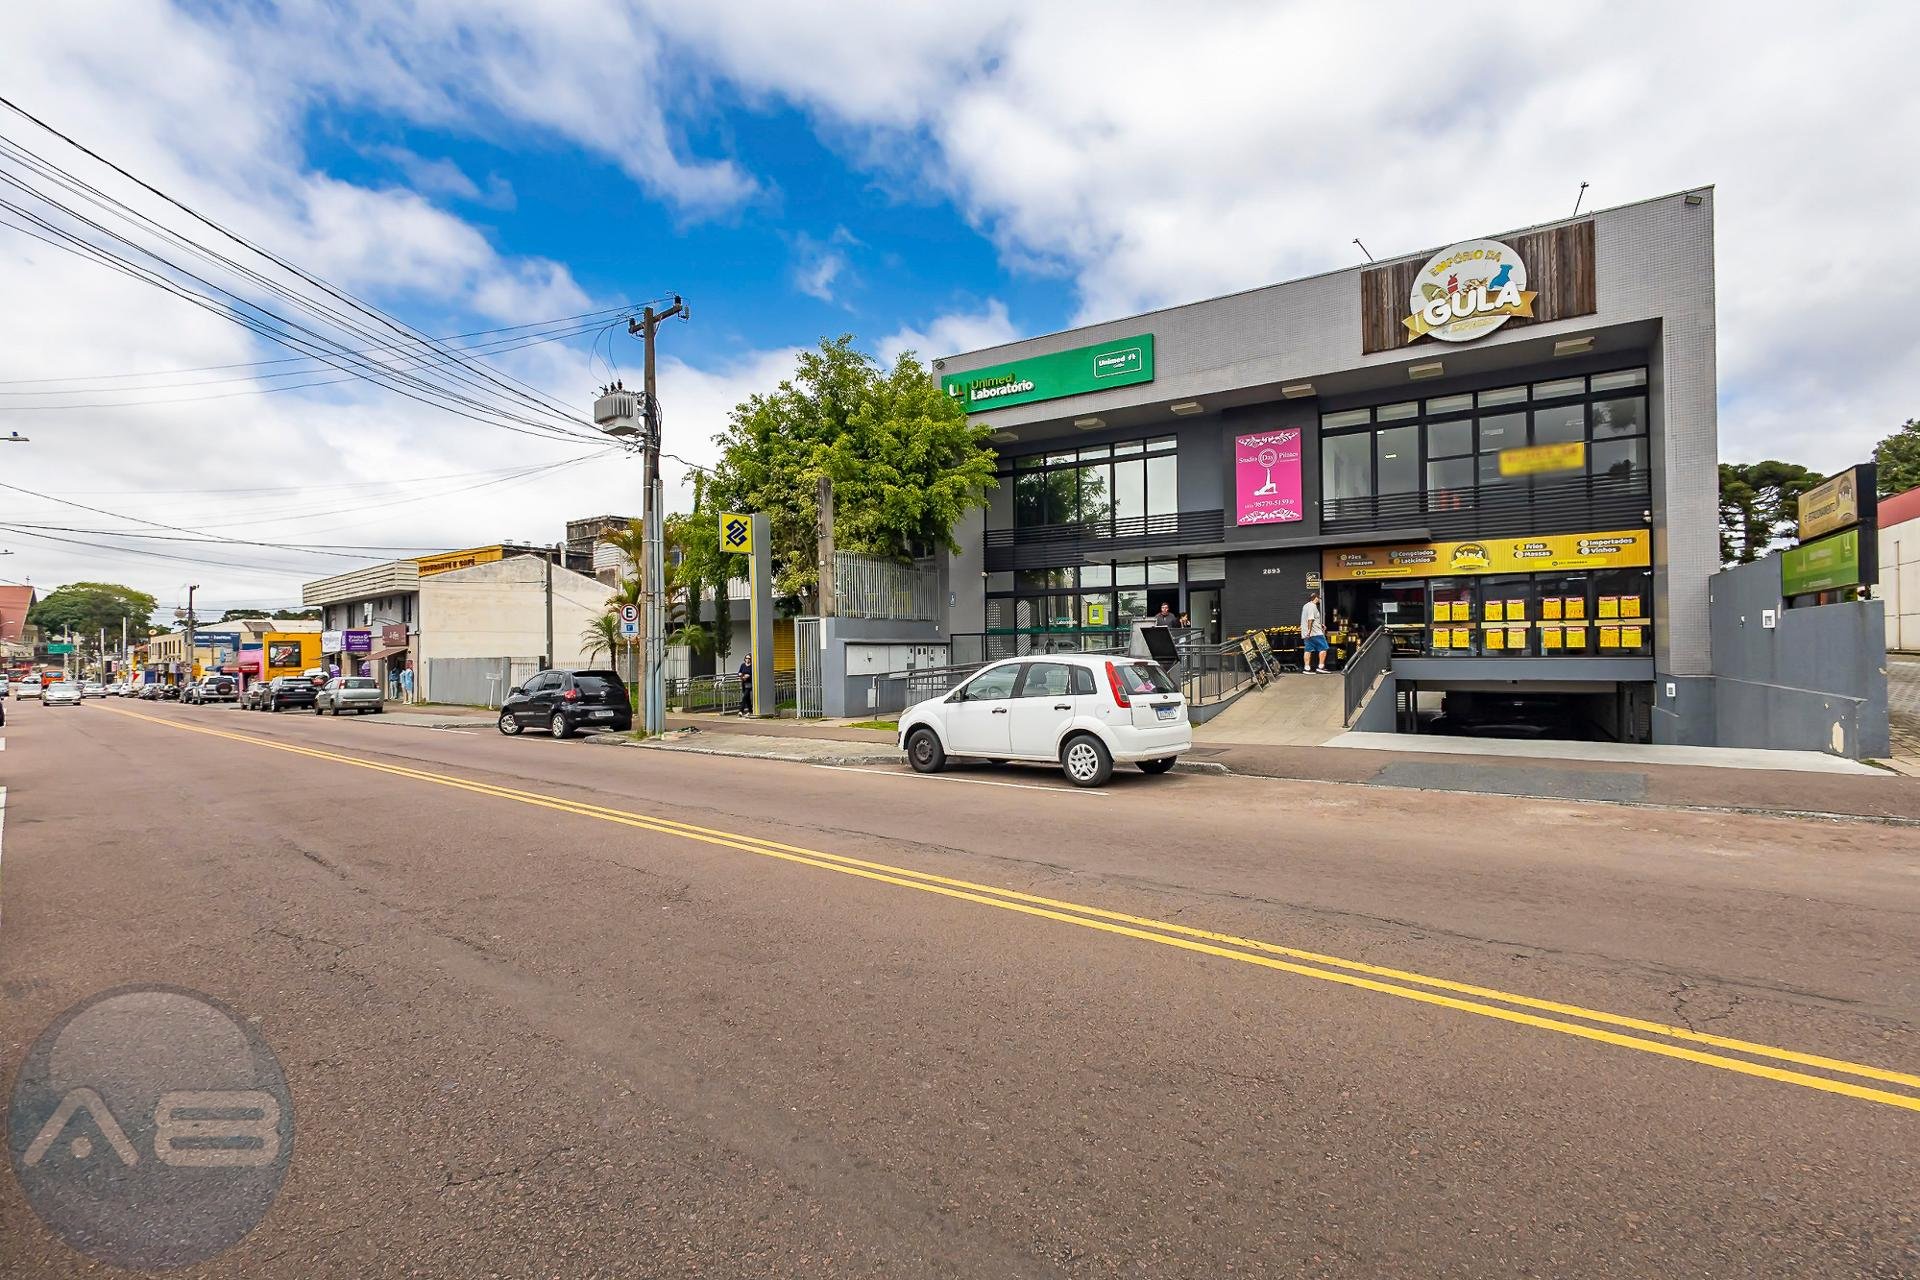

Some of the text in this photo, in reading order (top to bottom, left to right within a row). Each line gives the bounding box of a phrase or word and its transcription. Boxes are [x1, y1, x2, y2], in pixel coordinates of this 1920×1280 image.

[1423, 280, 1522, 326] GULA
[1098, 355, 1126, 368] Unimed
[972, 373, 1016, 390] Unimed
[971, 379, 1035, 400] Laboratório
[1589, 537, 1633, 547] Importados
[1590, 546, 1617, 554] Vinhos
[626, 607, 633, 618] E
